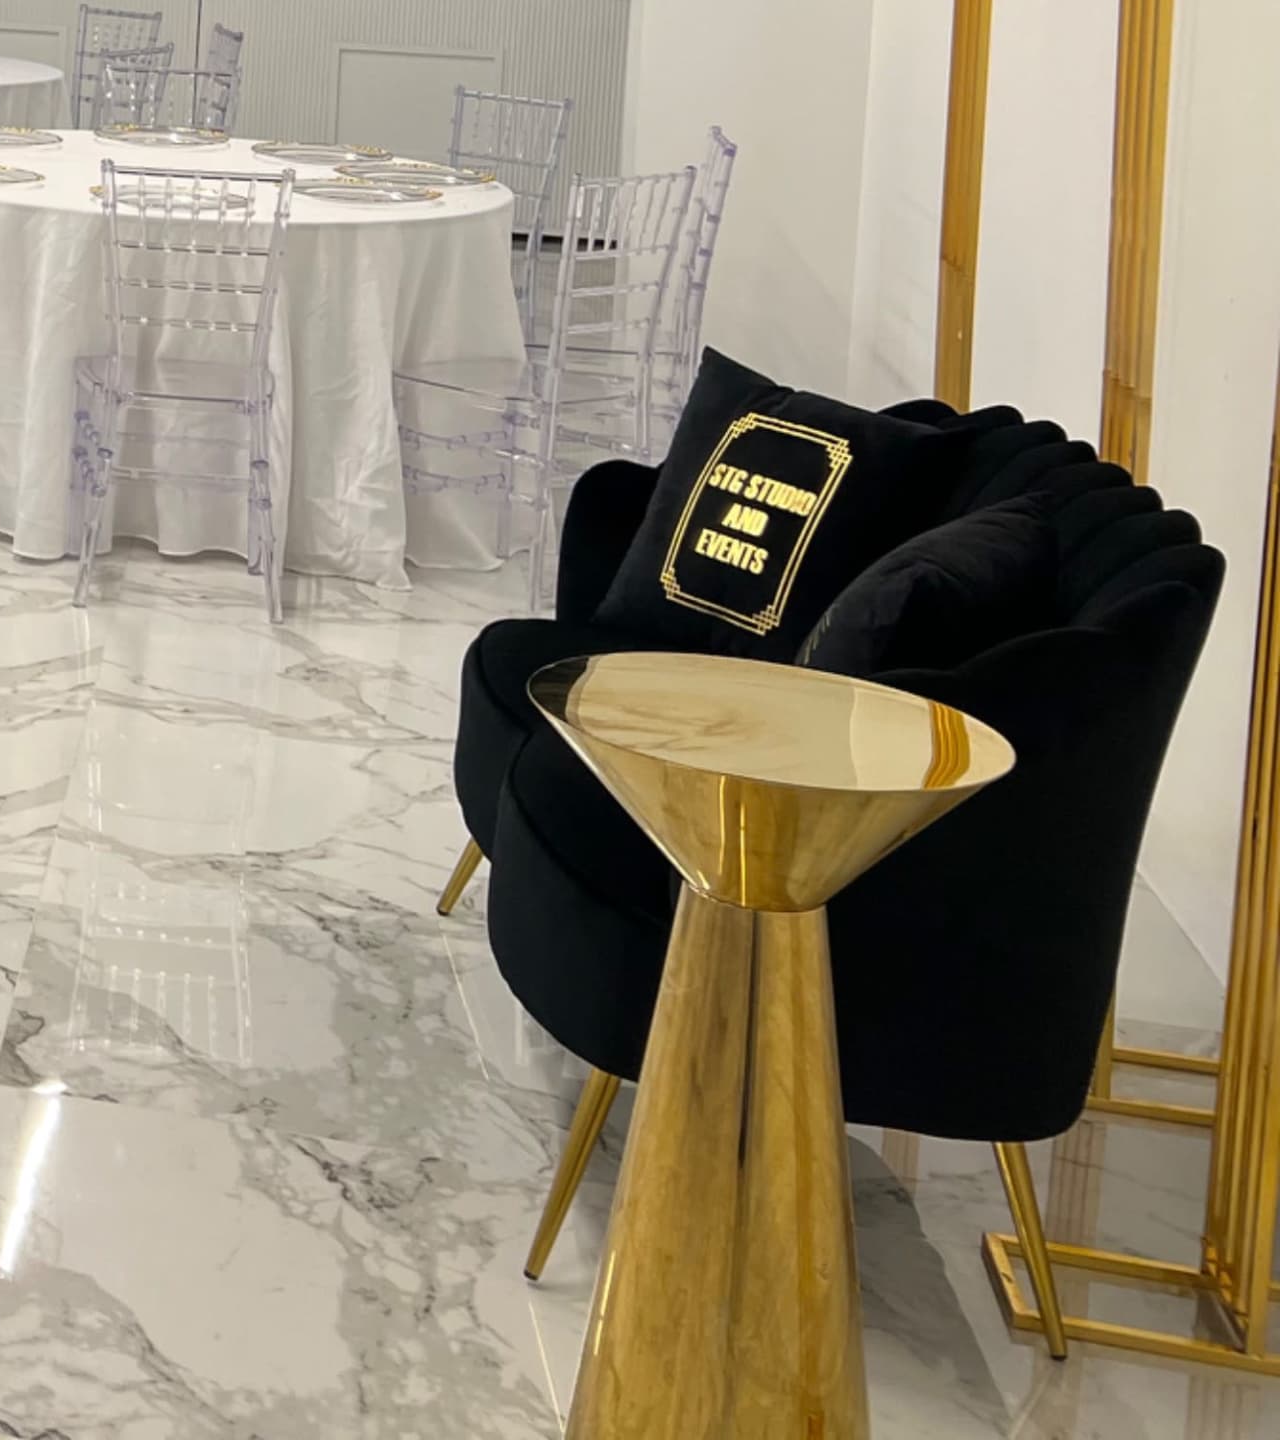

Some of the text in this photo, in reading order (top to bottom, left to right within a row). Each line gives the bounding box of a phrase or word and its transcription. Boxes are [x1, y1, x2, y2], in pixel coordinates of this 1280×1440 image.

[708, 463, 817, 517] STG STUDIO
[721, 503, 769, 537] AND
[695, 528, 769, 575] EVENTS
